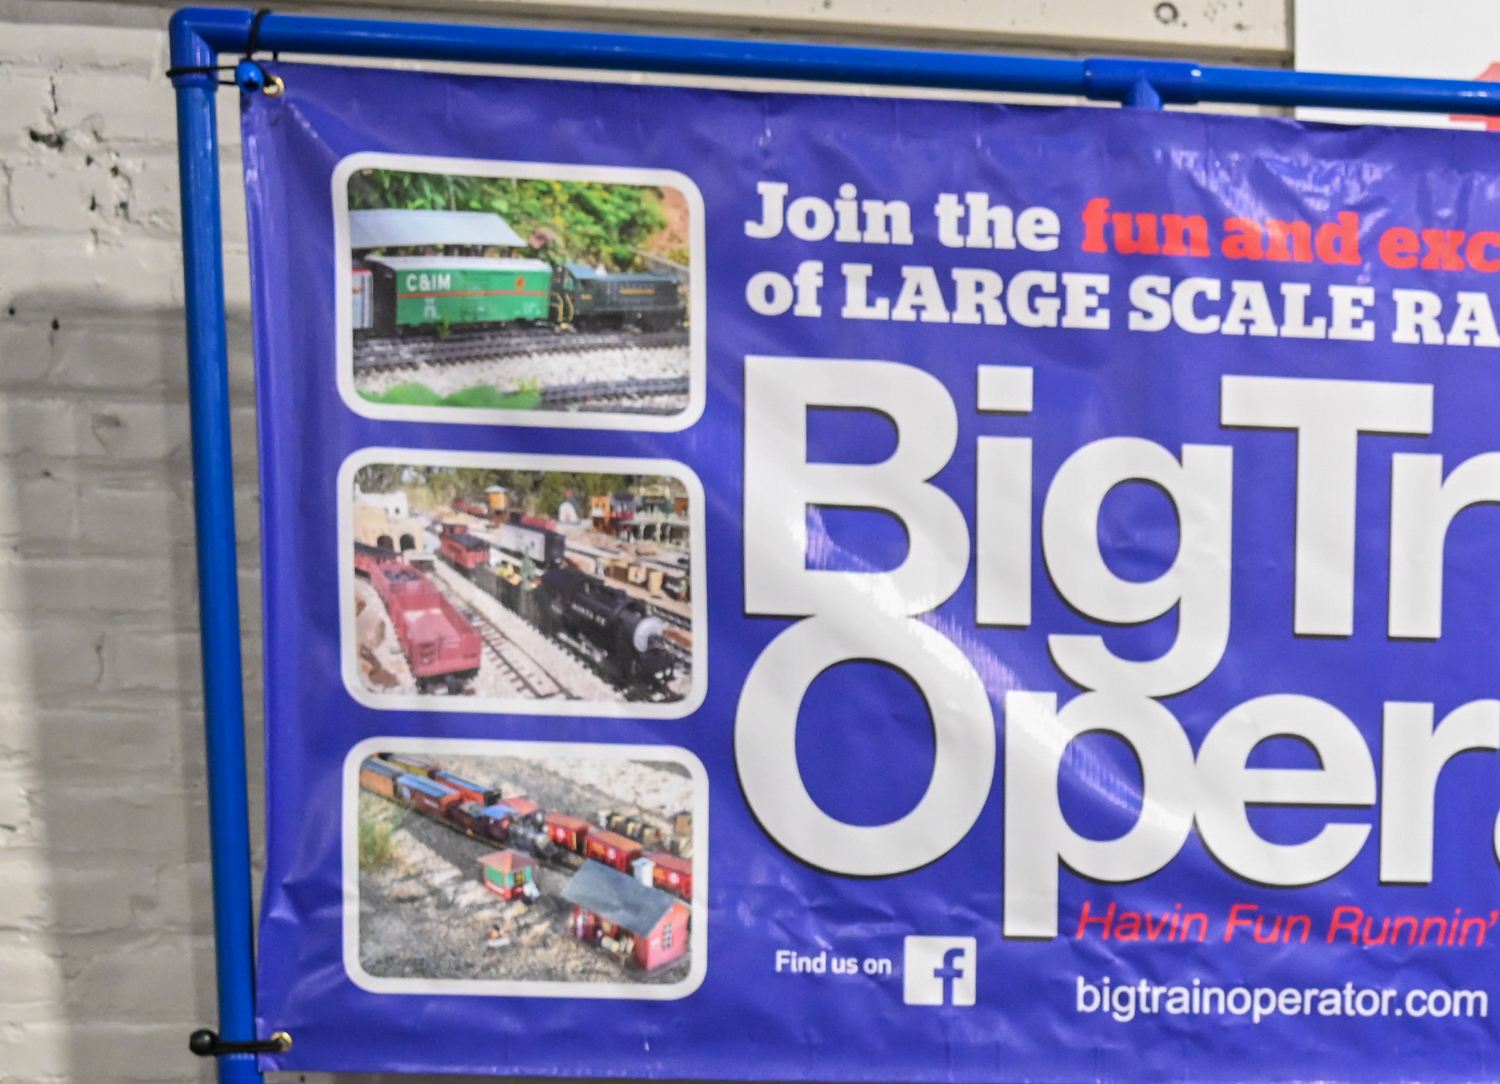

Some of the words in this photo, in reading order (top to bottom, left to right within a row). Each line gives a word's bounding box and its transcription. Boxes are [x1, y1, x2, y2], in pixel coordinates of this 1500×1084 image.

[745, 182, 914, 245] Join
[935, 192, 1060, 251] the
[1081, 197, 1210, 258] fun
[1221, 211, 1362, 265] and
[745, 261, 823, 317] of
[842, 263, 1109, 329] LARGE
[1128, 275, 1375, 341] SCALE
[1075, 901, 1209, 943] Havin
[1223, 903, 1312, 945] Fun
[775, 950, 825, 974] Find
[830, 957, 859, 975] us
[863, 957, 892, 976] on
[1076, 976, 1488, 1024] bigtrainoperator.com
